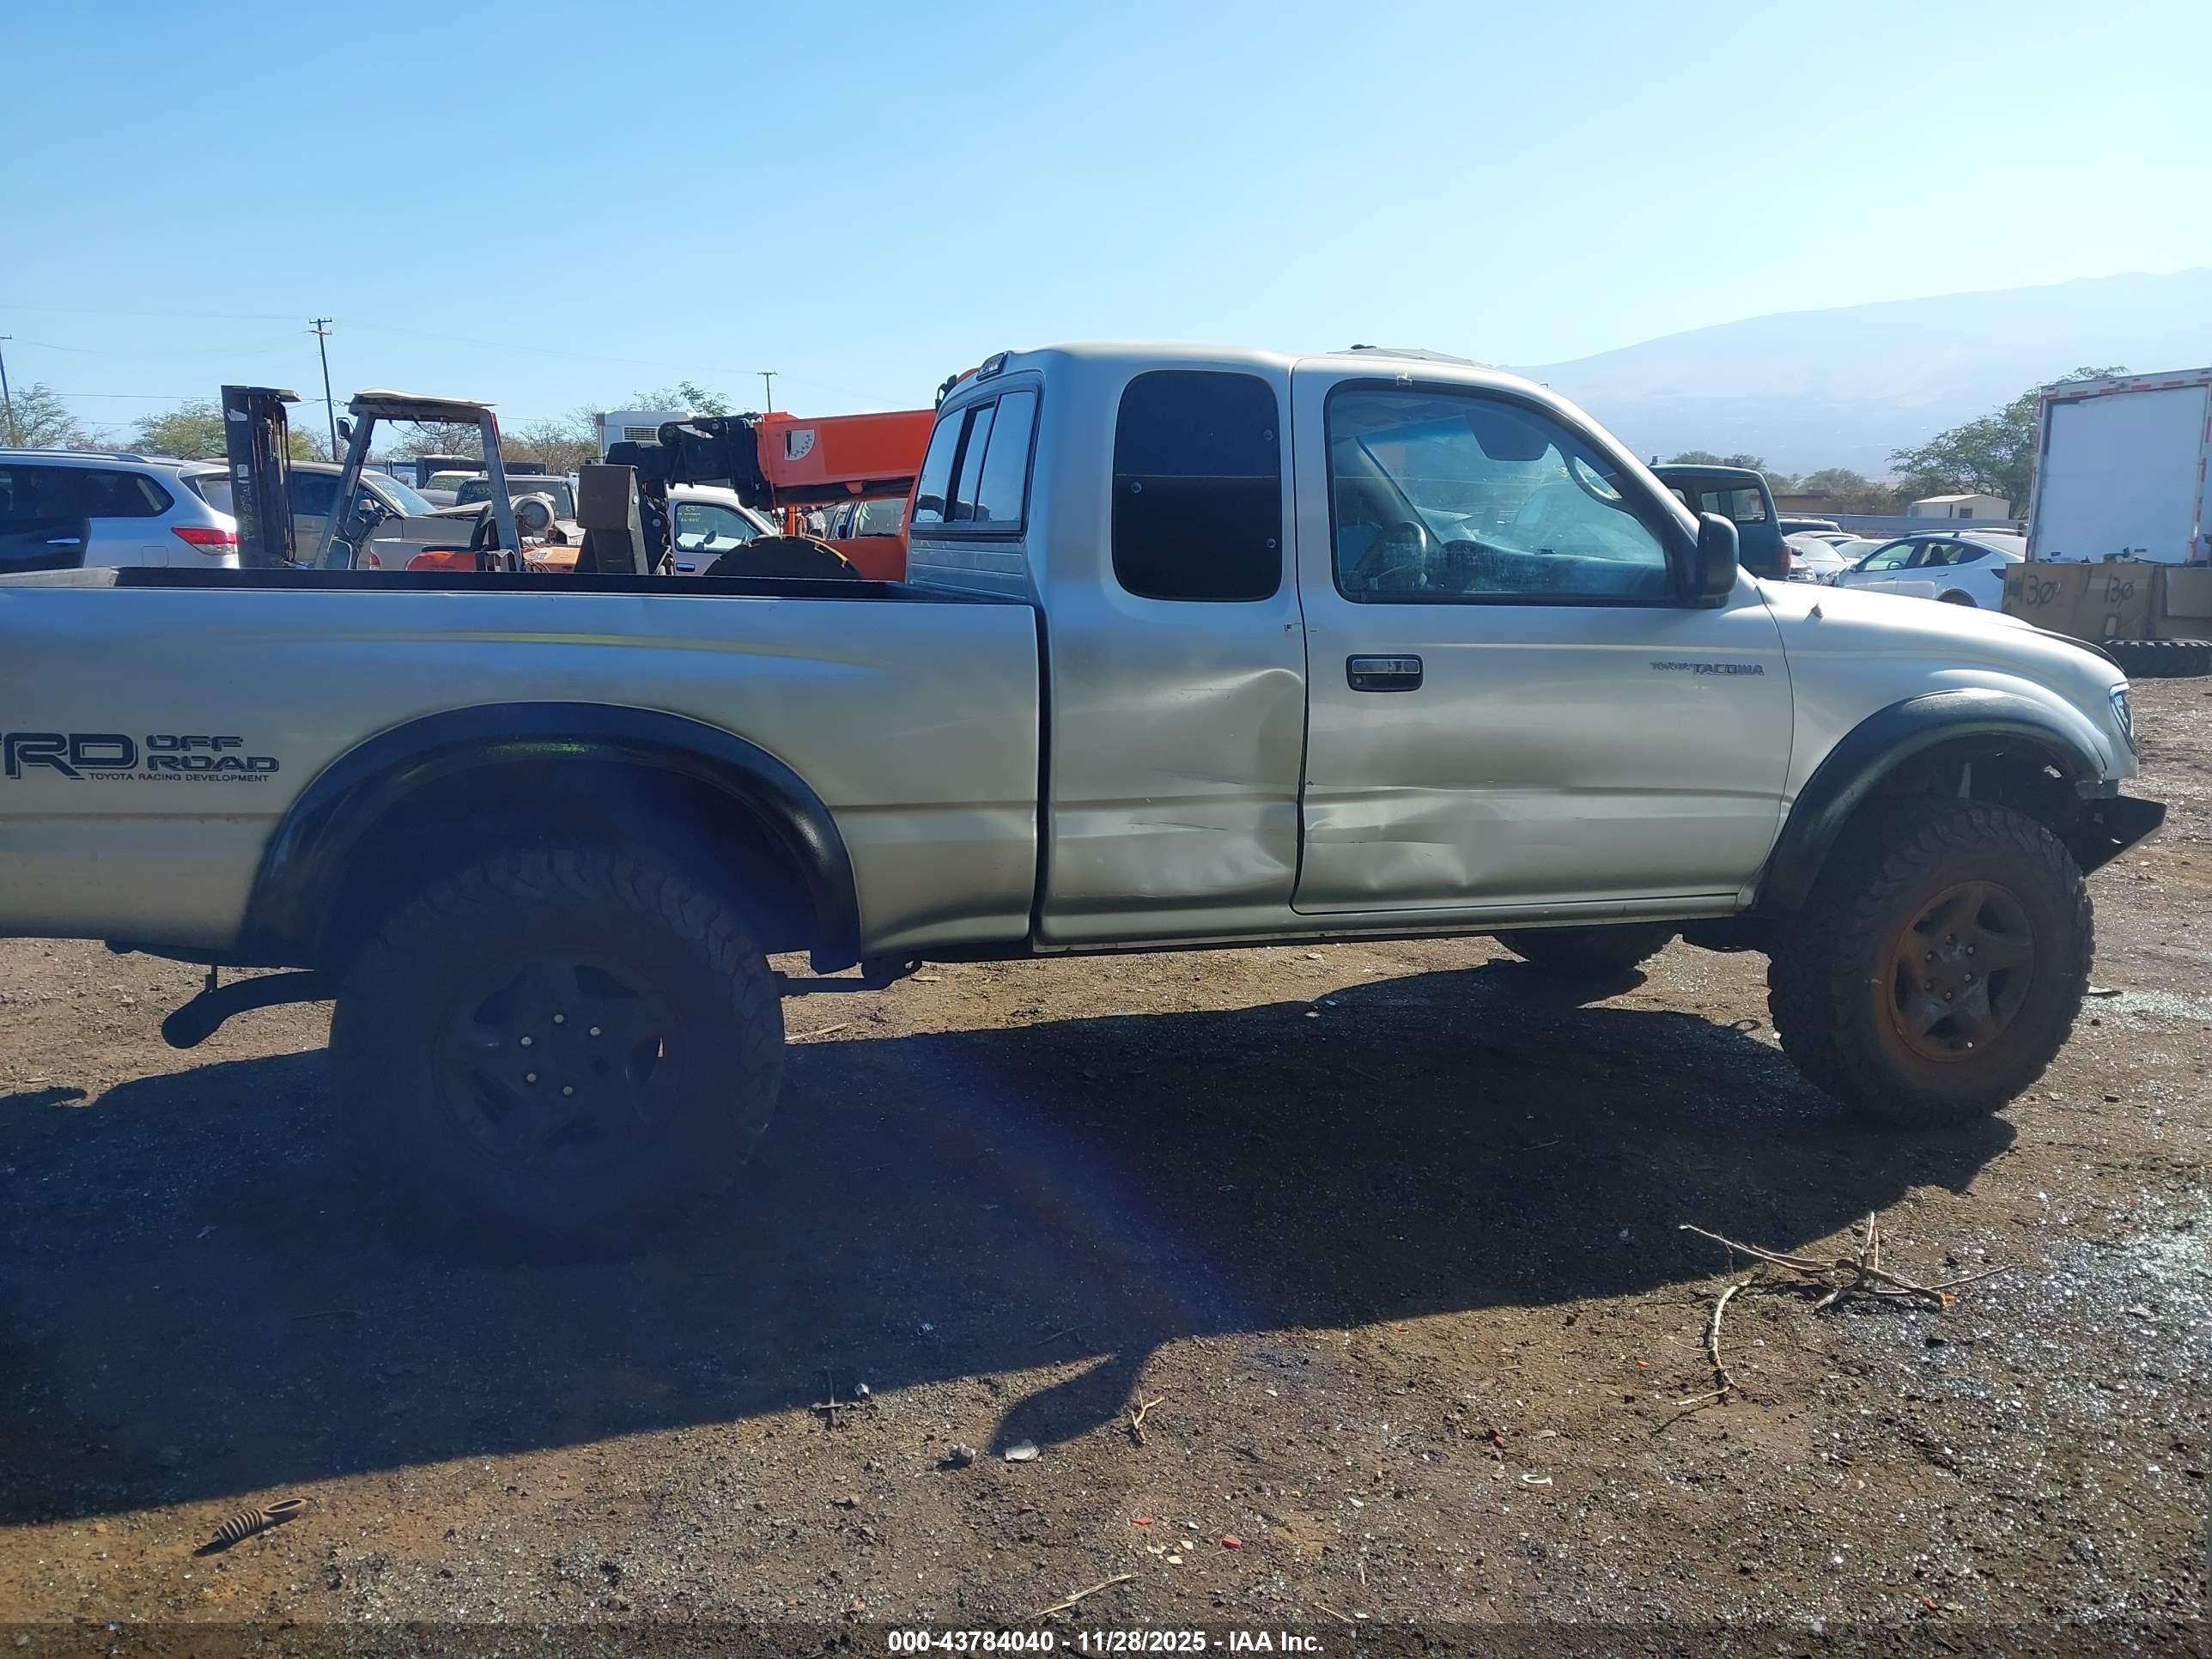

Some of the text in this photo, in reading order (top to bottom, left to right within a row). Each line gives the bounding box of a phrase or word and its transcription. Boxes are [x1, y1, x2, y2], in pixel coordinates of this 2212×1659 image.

[1691, 663, 1765, 676] TACOMA
[0, 732, 244, 781] RD OFF
[147, 755, 280, 773] ROAD
[89, 772, 269, 783] TOYOTA RACING DEVELOPMENT
